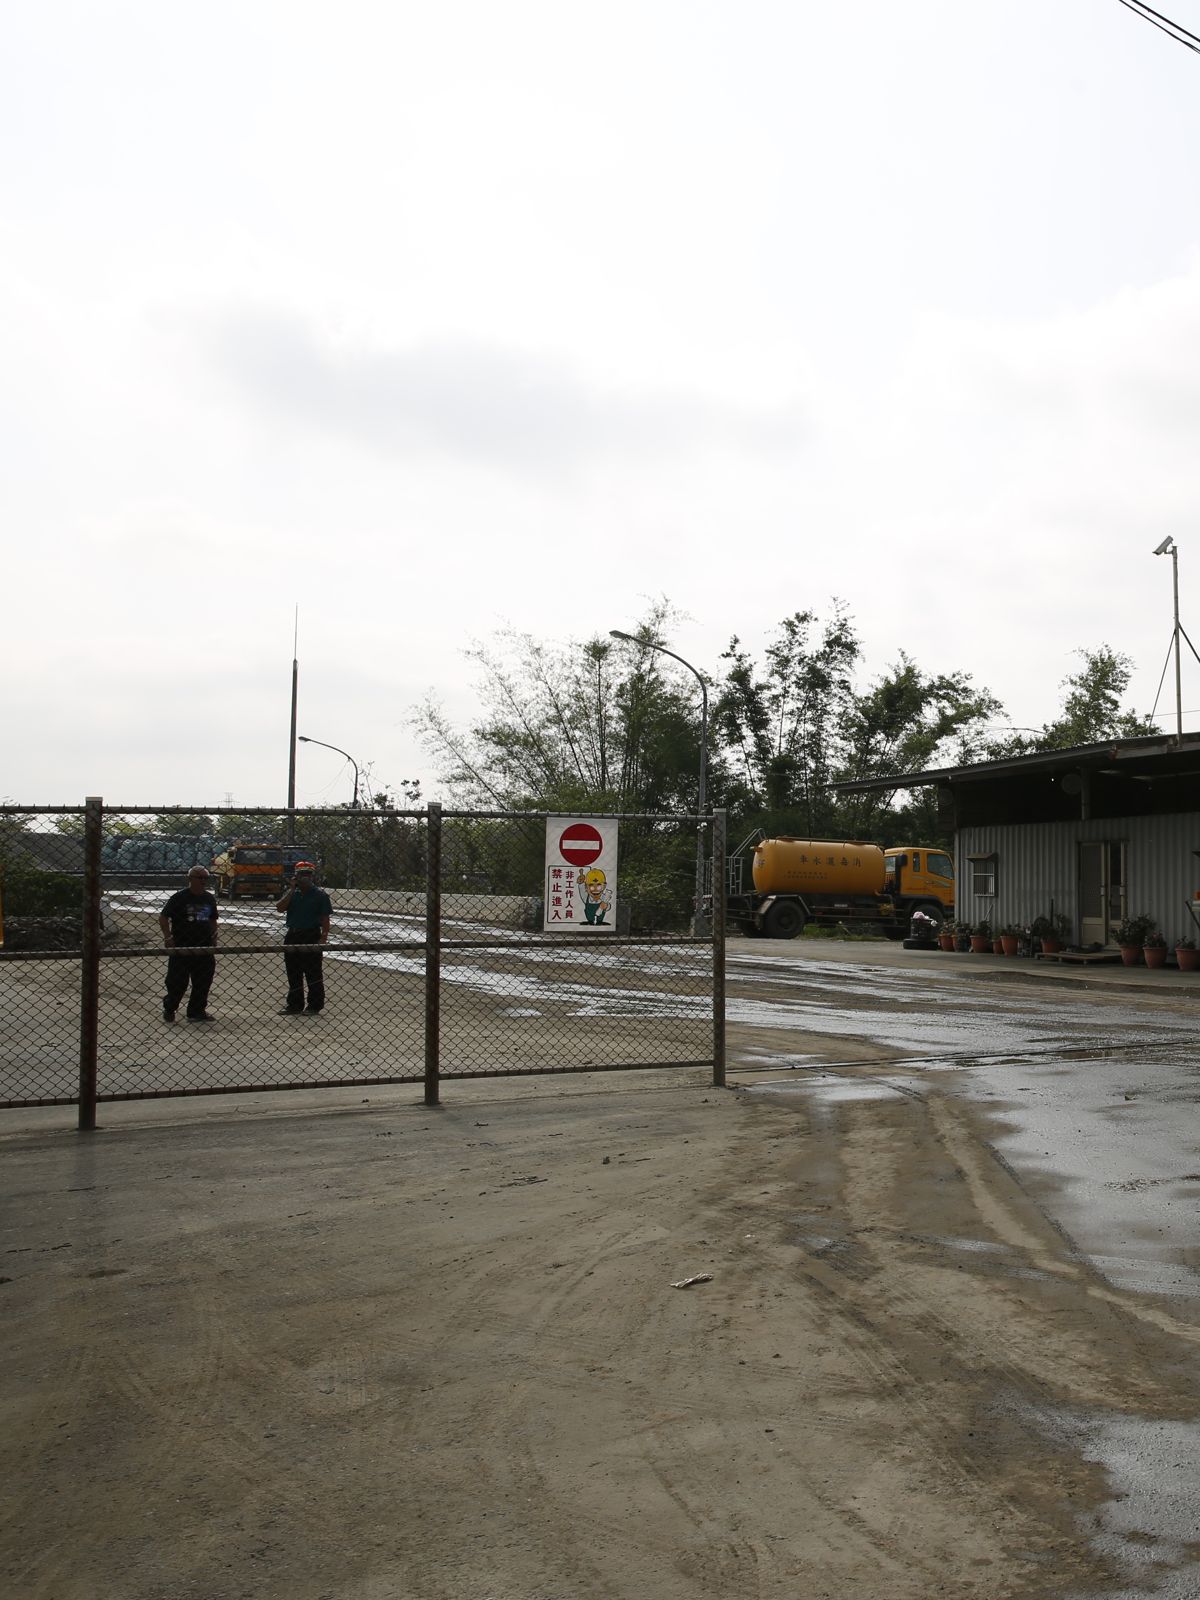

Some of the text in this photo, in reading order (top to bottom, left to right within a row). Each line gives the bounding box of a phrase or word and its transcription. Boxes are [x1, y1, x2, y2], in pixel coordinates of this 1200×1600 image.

[551, 868, 563, 920] 禁止進入
[565, 871, 575, 919] 非工作人員
